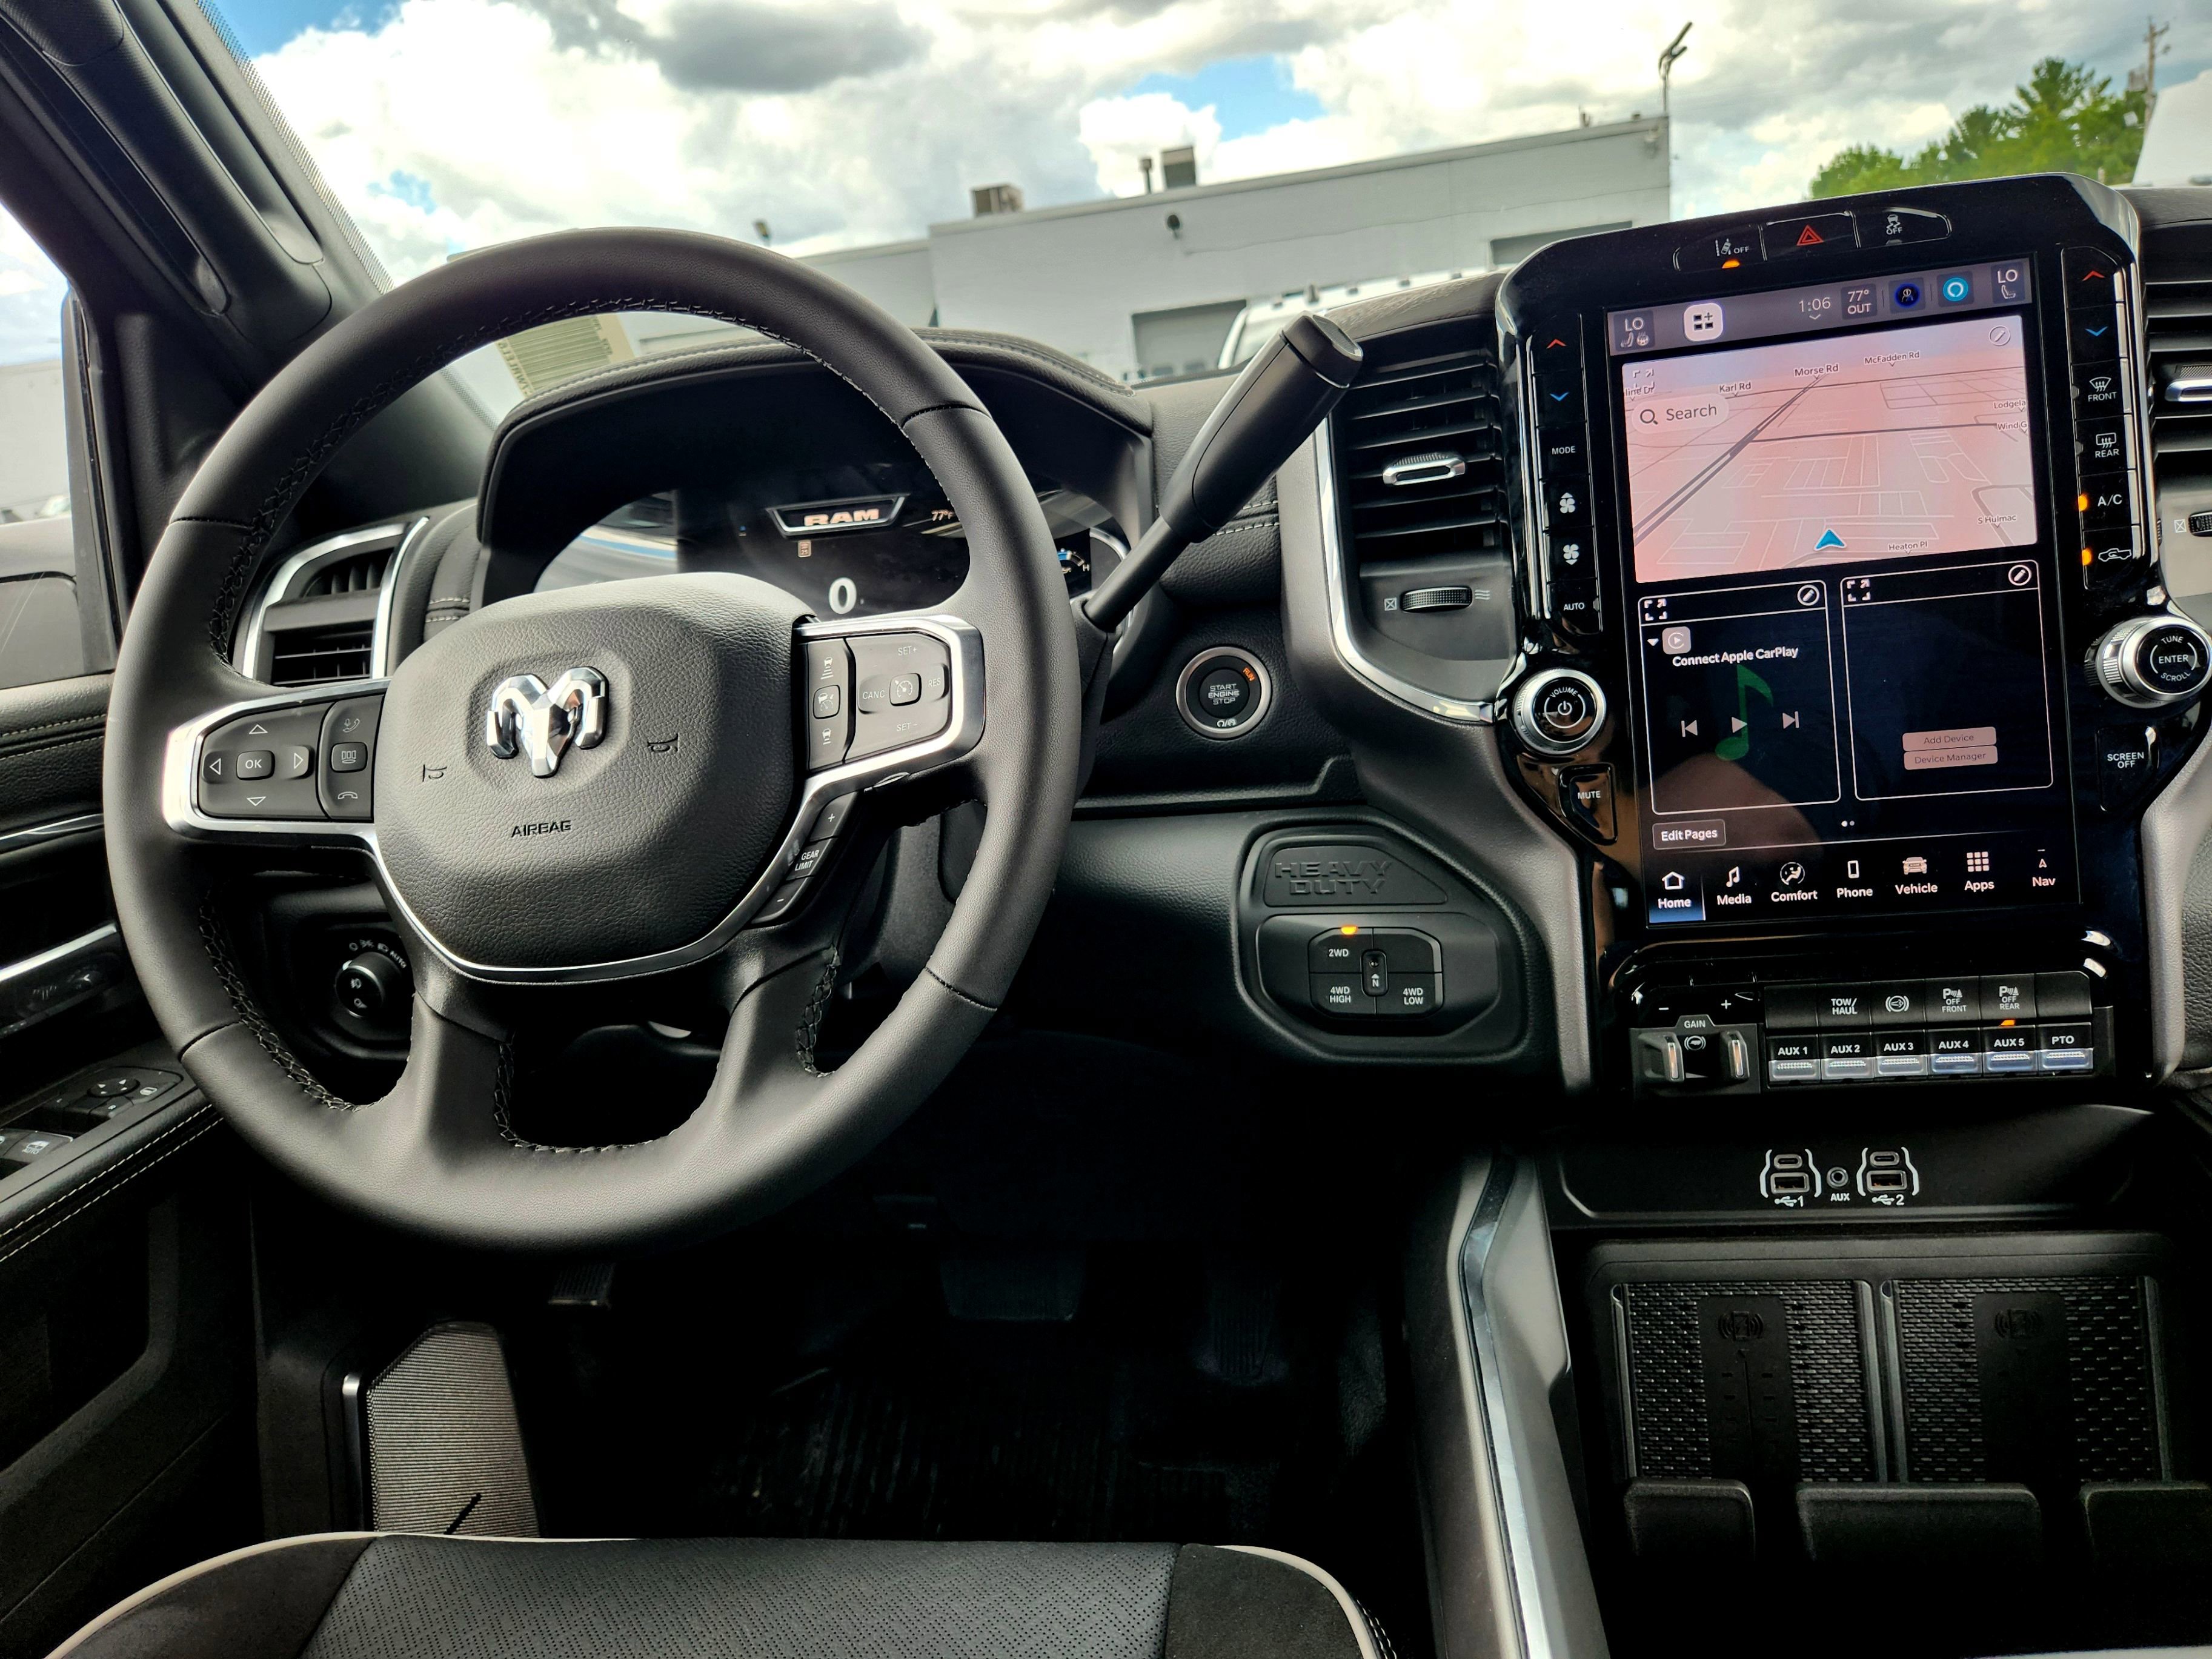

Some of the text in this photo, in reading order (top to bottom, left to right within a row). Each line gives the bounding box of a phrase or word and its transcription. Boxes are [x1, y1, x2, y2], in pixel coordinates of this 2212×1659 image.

[1886, 227, 1902, 235] OFF
[1733, 245, 1750, 254] OFF
[1998, 269, 2018, 284] LO
[1847, 289, 1870, 302] 77°
[1798, 296, 1831, 313] 1:06
[1848, 304, 1872, 314] OUT
[1624, 317, 1644, 331] LO
[1865, 353, 1907, 364] McFadden
[1795, 364, 1839, 377] Morse Rd
[1719, 382, 1752, 393] Karl Rd
[2088, 392, 2117, 402] FRONT
[1666, 404, 1717, 421] Search
[1998, 422, 2019, 431] Wind
[1552, 446, 1576, 454] MODE
[2095, 448, 2119, 458] REAR
[2097, 494, 2122, 507] A/C
[804, 508, 880, 527] RAM
[1888, 542, 1918, 551] Heaton
[1083, 564, 1090, 573] H
[828, 577, 857, 614] 0
[1563, 602, 1585, 611] AUTO
[2161, 635, 2184, 644] TUNE
[1672, 646, 1799, 667] Connect Apple CarPlay
[2158, 654, 2188, 664] ENTER
[1243, 667, 1256, 682] RUN
[2161, 671, 2191, 682] SCROLL
[928, 677, 941, 688] RES
[863, 690, 885, 700] CANC
[1208, 690, 1240, 699] ENGINE
[1550, 687, 1578, 698] VOLUME
[1924, 734, 1974, 745] Add Device
[1915, 752, 1987, 764] Device Manager
[2107, 752, 2144, 762] SCREEN
[245, 759, 262, 769] OK
[2117, 760, 2136, 768] OFF
[1578, 790, 1601, 799] MUTE
[511, 820, 571, 839] AIRBAG
[1661, 829, 1718, 842] Edit Pages
[801, 849, 820, 860] GEAR
[794, 860, 814, 871] LIMIT
[1275, 860, 1393, 878] HEAVY
[1964, 880, 1994, 893] Apps
[2032, 876, 2056, 887] Nav
[1289, 879, 1386, 896] DUTY
[1836, 887, 1873, 898] Phone
[1895, 882, 1938, 895] Vehicle
[1717, 894, 1752, 905] Media
[1771, 889, 1818, 902] Comfort
[1658, 897, 1692, 909] Home
[1328, 948, 1349, 957] 2WD
[390, 951, 407, 968] AUTO
[1372, 979, 1380, 988] N
[1330, 986, 1350, 995] 4WD
[1403, 988, 1423, 997] 4WD
[1329, 994, 1351, 1004] HIGH
[1404, 996, 1424, 1005] LOW
[1831, 997, 1857, 1007] TOW/
[1832, 1006, 1858, 1016] HAUL
[1942, 1005, 1967, 1013] FRONT
[1684, 1019, 1706, 1028] GAIN
[1939, 1040, 1969, 1049] AUX 4
[1994, 1038, 2025, 1048] AUX 5
[2051, 1036, 2074, 1045] PTO
[1778, 1046, 1808, 1056] AUX 1
[1831, 1044, 1861, 1054] AUX 2
[1884, 1042, 1914, 1051] AUX 3
[1797, 1195, 1804, 1208] 1
[1830, 1192, 1850, 1202] AUX
[1896, 1194, 1905, 1206] 2
